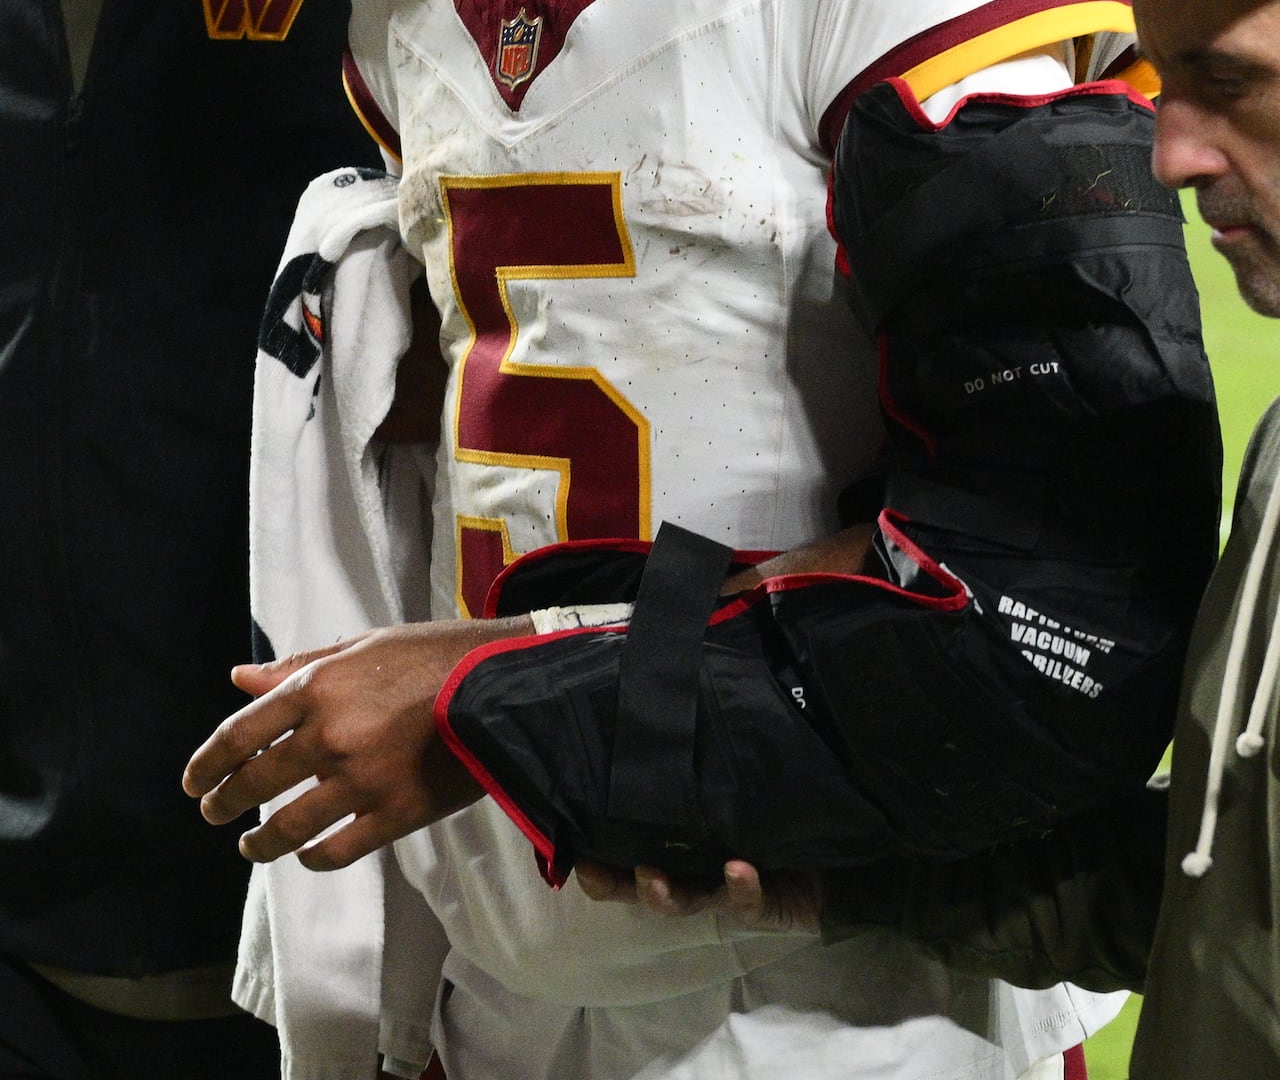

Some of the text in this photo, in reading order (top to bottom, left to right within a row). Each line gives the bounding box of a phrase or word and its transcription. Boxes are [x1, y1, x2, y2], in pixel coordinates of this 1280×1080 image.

[439, 170, 652, 620] 5
[964, 362, 1059, 394] DO NOT CUT
[1010, 622, 1091, 667] VACUUM
